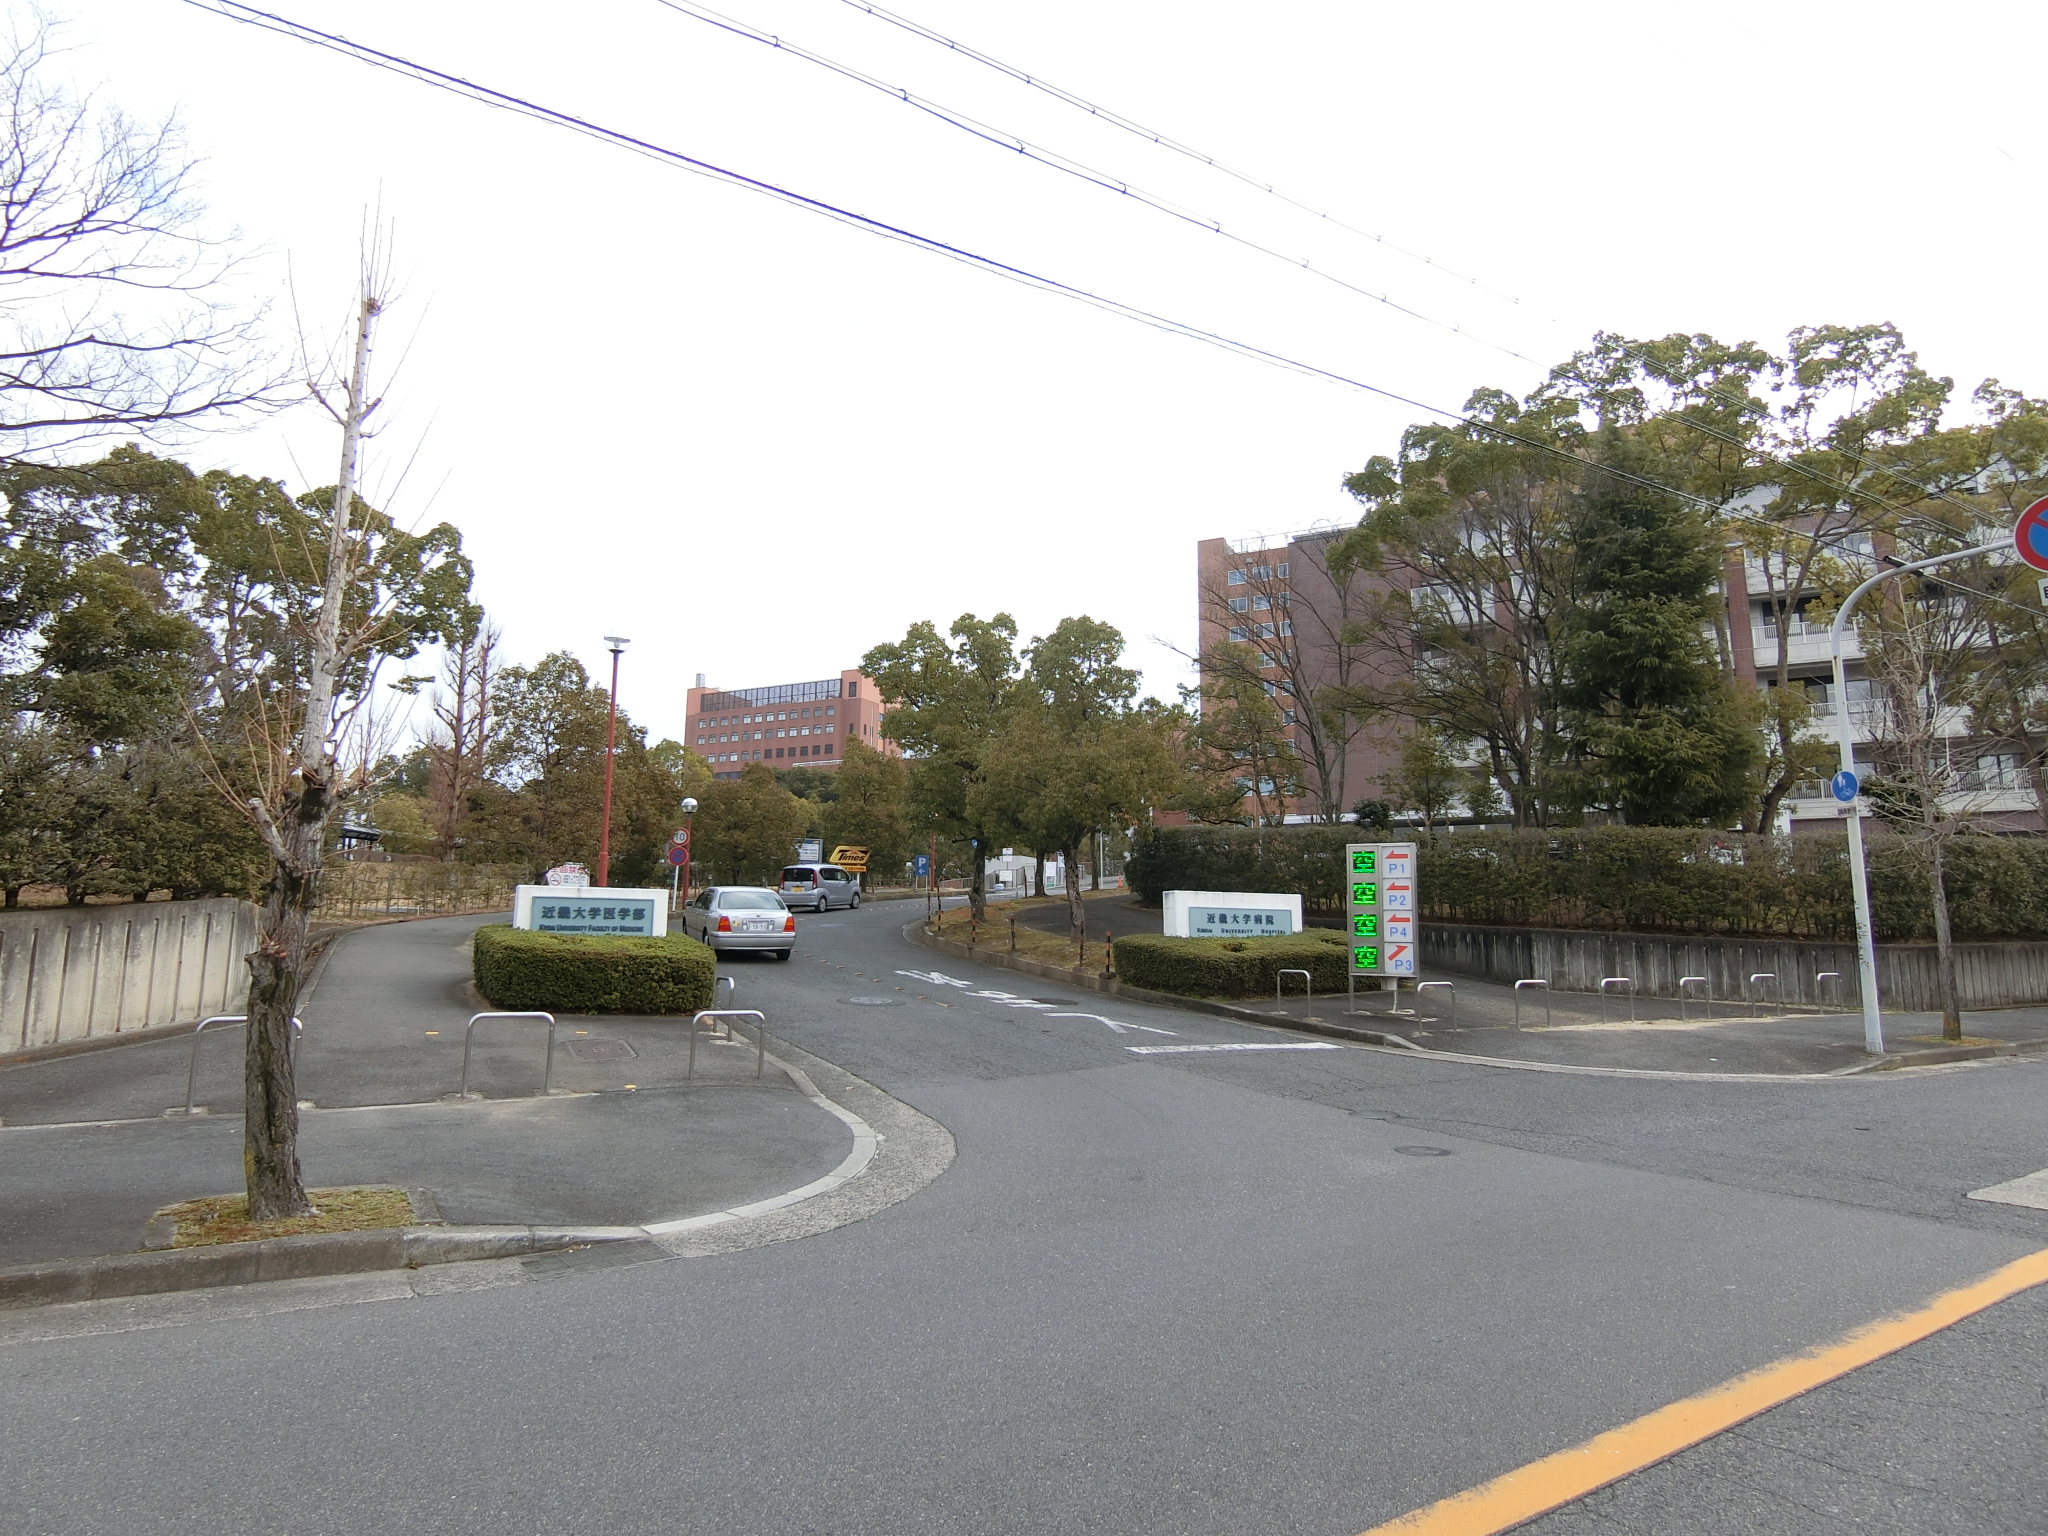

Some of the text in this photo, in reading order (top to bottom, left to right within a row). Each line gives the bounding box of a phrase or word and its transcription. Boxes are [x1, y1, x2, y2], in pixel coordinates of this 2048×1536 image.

[675, 832, 686, 841] 10
[837, 850, 868, 861] Times
[1352, 850, 1375, 873] 空
[918, 858, 926, 867] P
[1388, 863, 1405, 874] P1
[1352, 882, 1376, 905] 空
[1388, 895, 1406, 906] P2
[542, 906, 646, 921] 近畿大学医学部
[1206, 913, 1275, 926] 近畿大学病院
[1353, 913, 1378, 937] 空
[1389, 926, 1407, 938] P4
[1354, 945, 1378, 969] 空
[1394, 959, 1412, 971] P3
